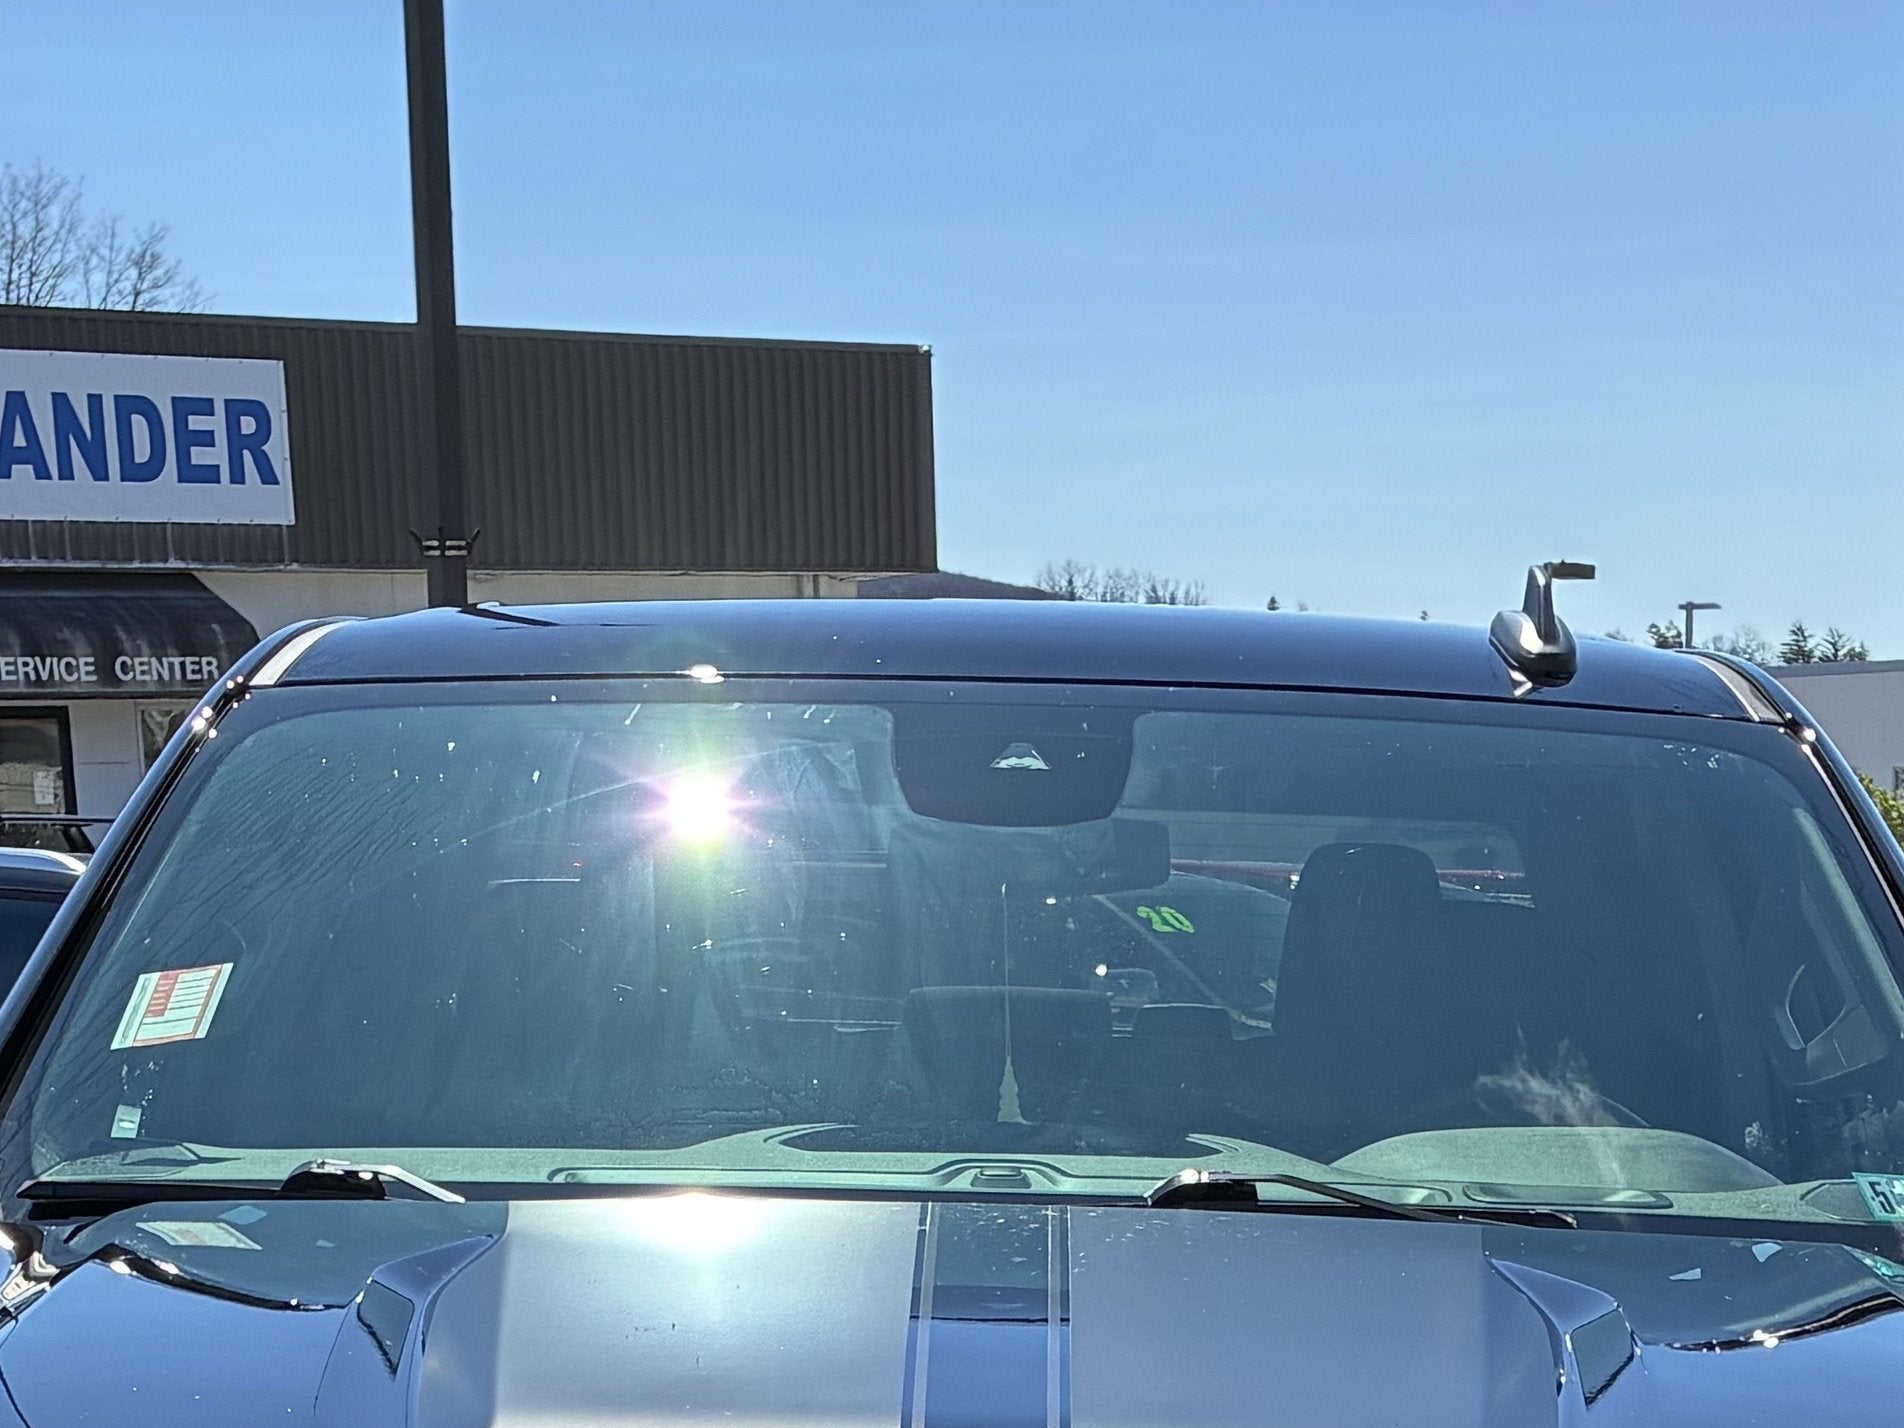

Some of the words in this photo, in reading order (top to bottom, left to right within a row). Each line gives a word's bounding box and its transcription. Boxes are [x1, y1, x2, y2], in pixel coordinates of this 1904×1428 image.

[113, 654, 220, 682] CENTER
[1137, 906, 1195, 933] 20
[1868, 1181, 1896, 1215] 5
